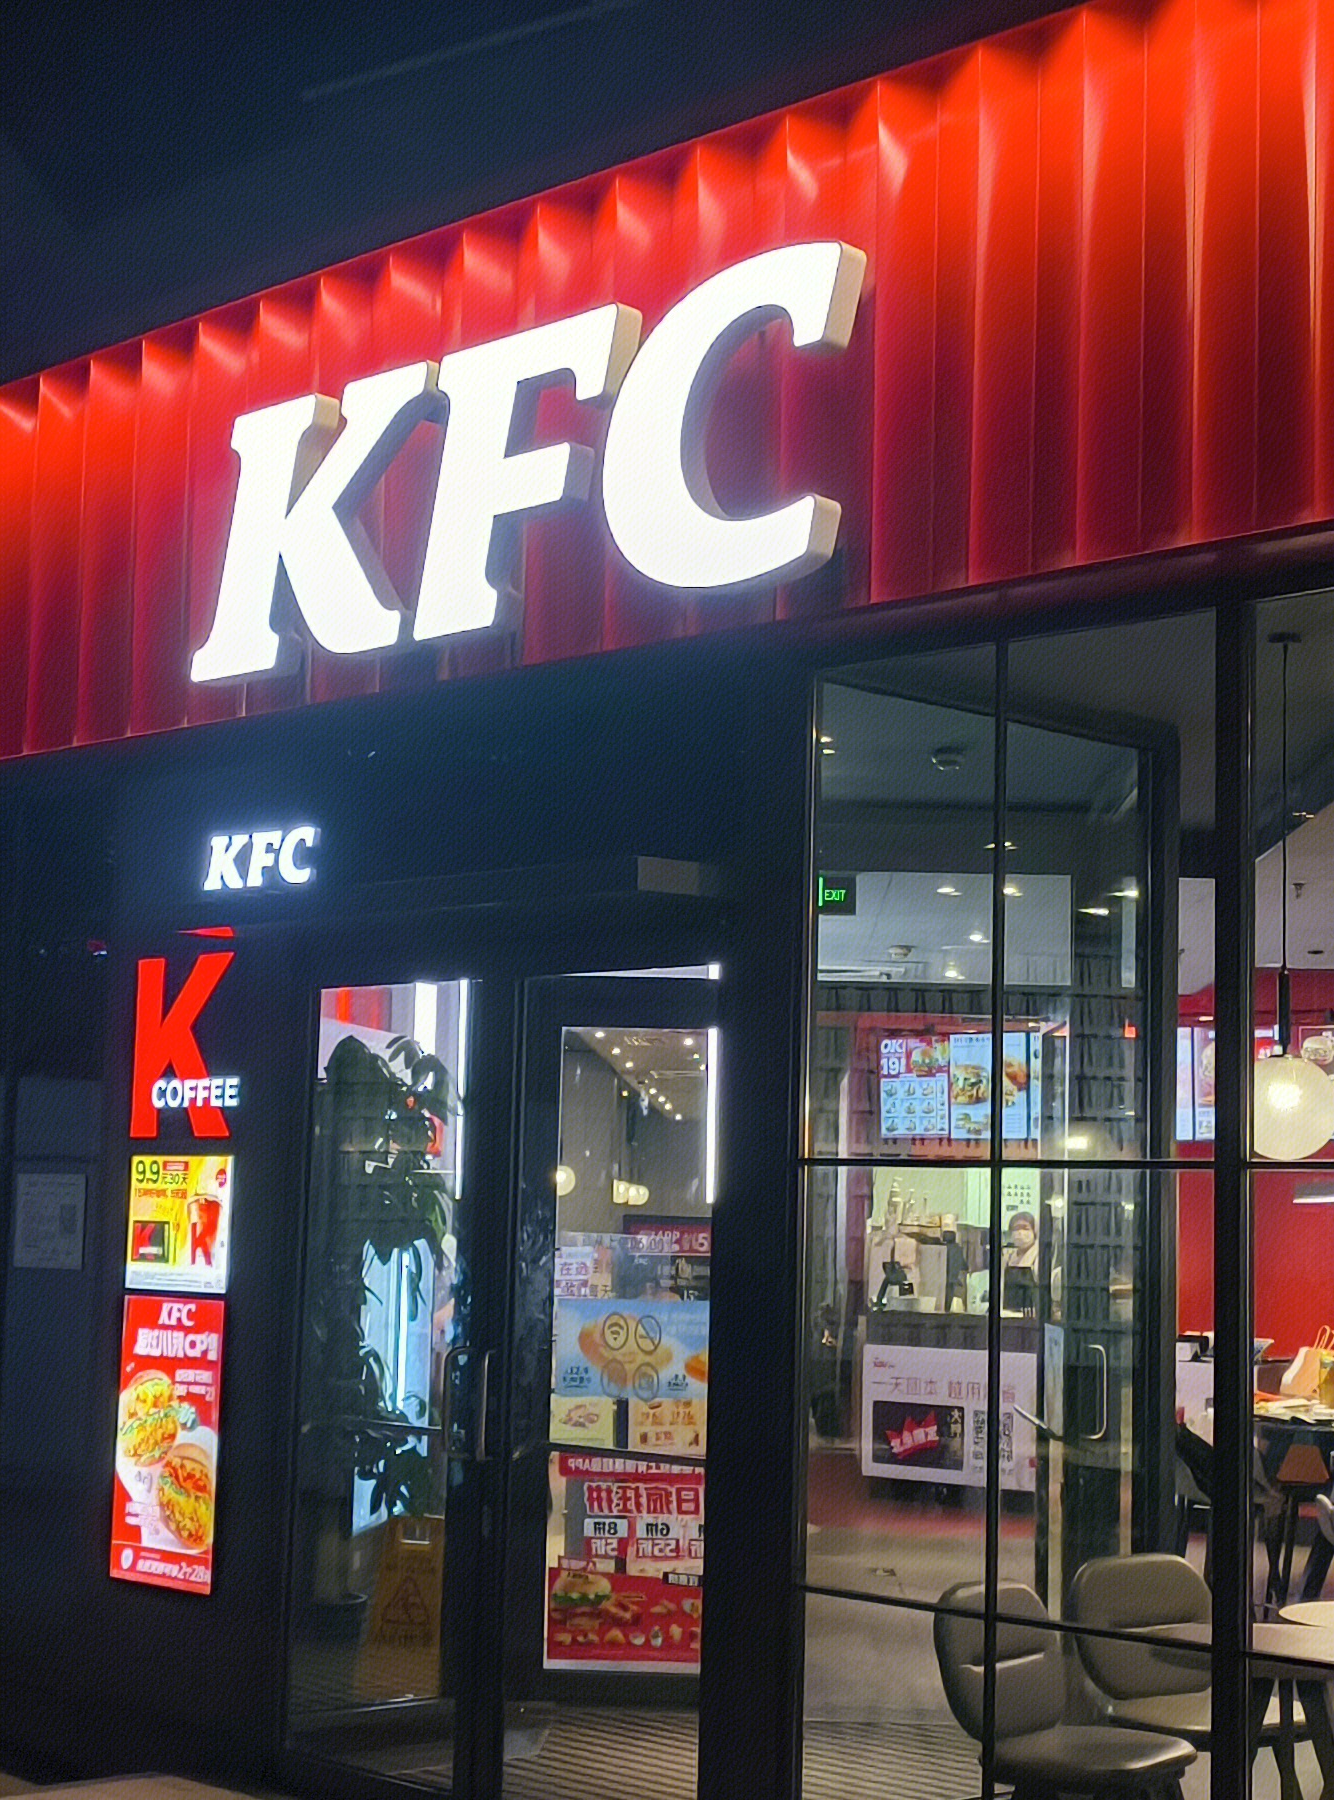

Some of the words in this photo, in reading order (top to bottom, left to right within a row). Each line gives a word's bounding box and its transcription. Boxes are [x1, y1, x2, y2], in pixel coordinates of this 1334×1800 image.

[190, 241, 857, 683] KFC
[203, 826, 318, 891] KFC
[824, 889, 846, 902] EXIT
[130, 952, 235, 1138] K
[151, 1077, 240, 1108] COFFEE
[157, 1302, 196, 1327] KFC
